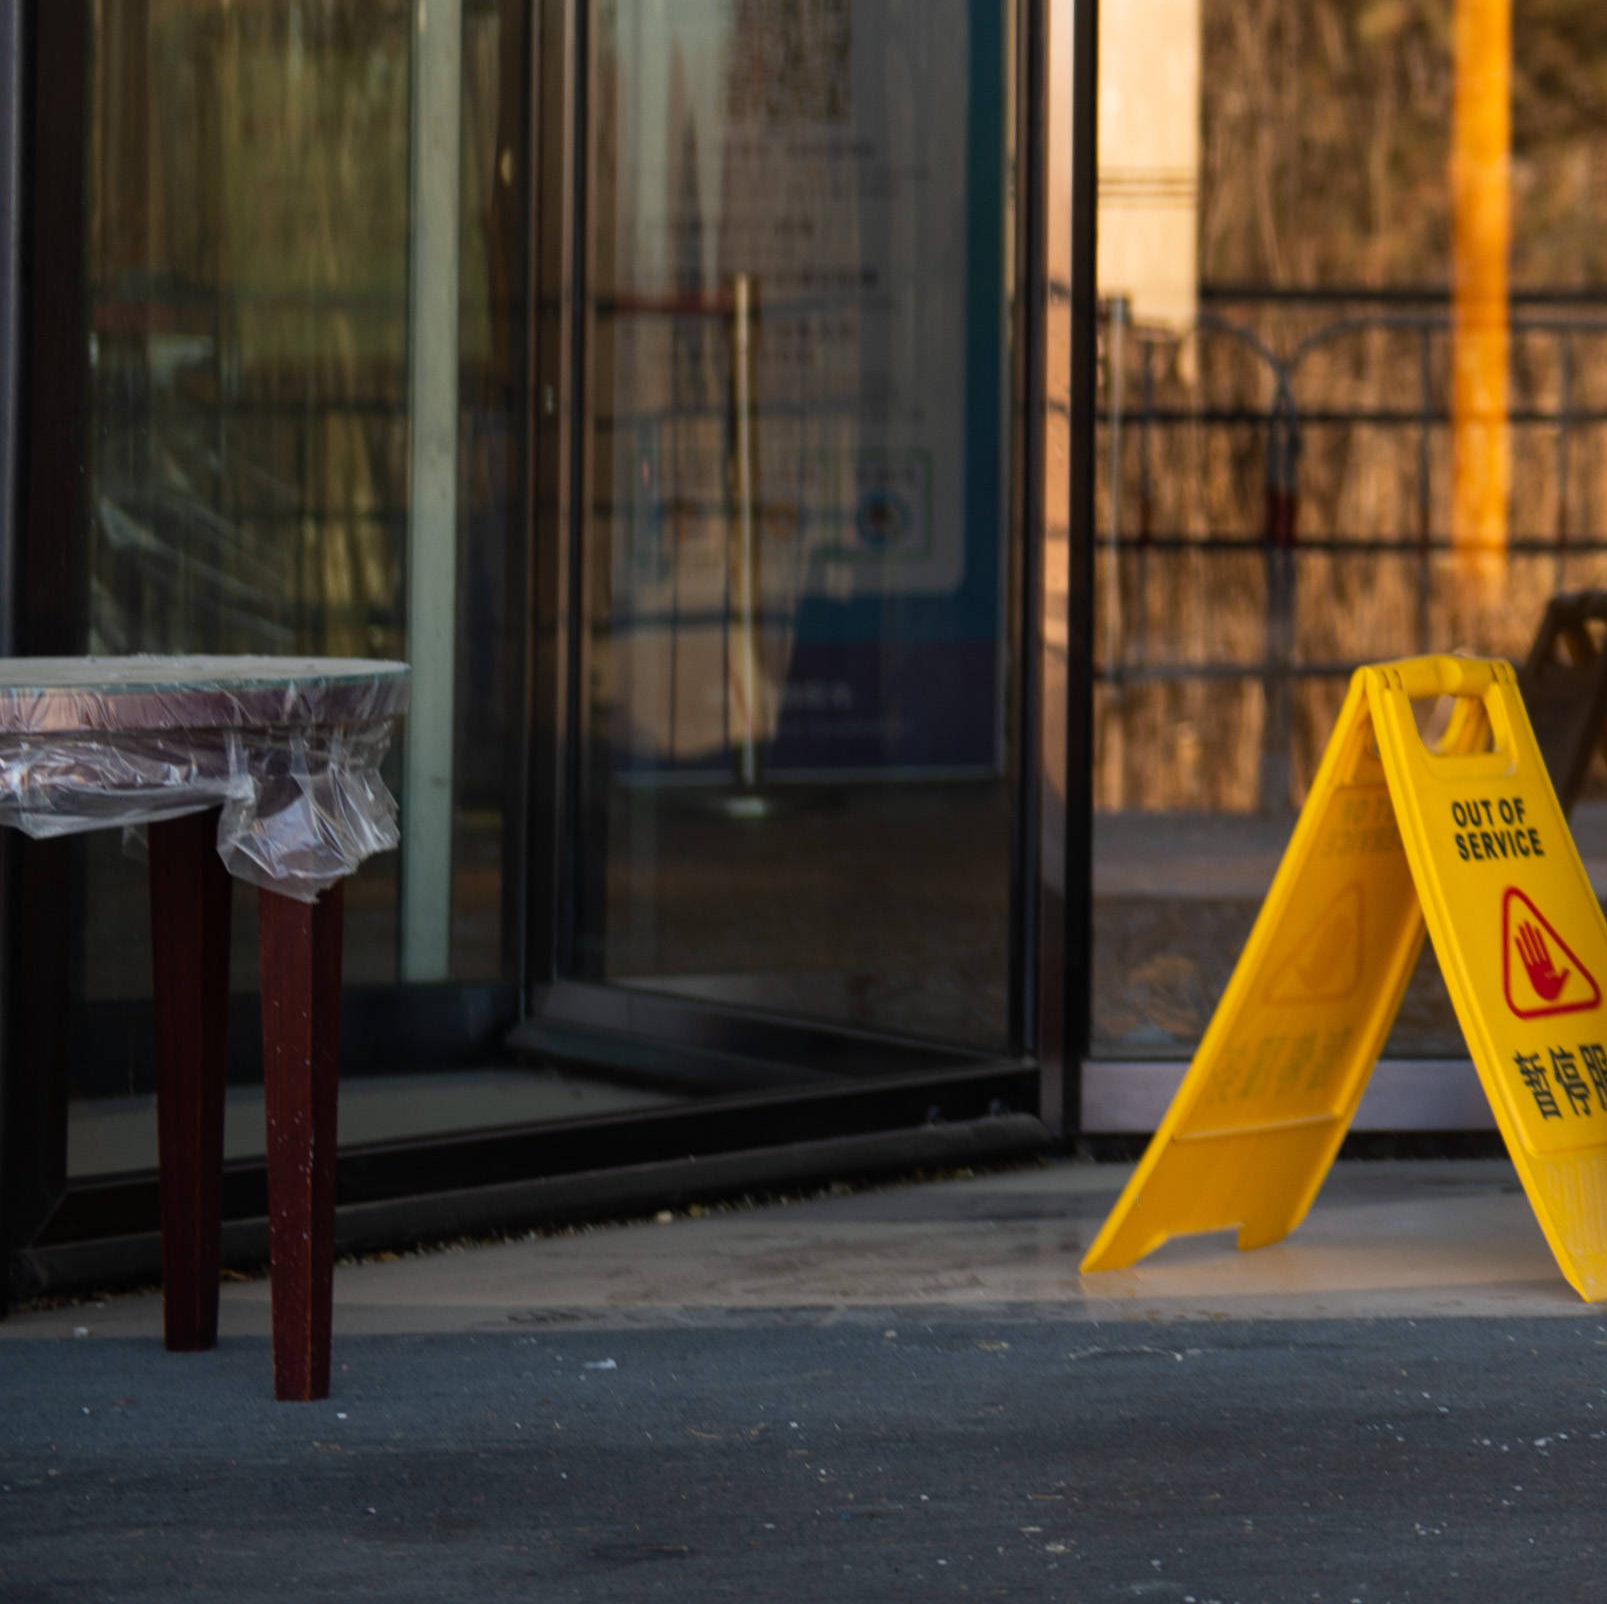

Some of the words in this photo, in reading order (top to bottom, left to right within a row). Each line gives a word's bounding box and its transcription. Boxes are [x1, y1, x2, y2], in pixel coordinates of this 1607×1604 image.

[1452, 800, 1494, 828] OUT
[1499, 798, 1526, 825] OF
[1455, 829, 1545, 861] SERVICE
